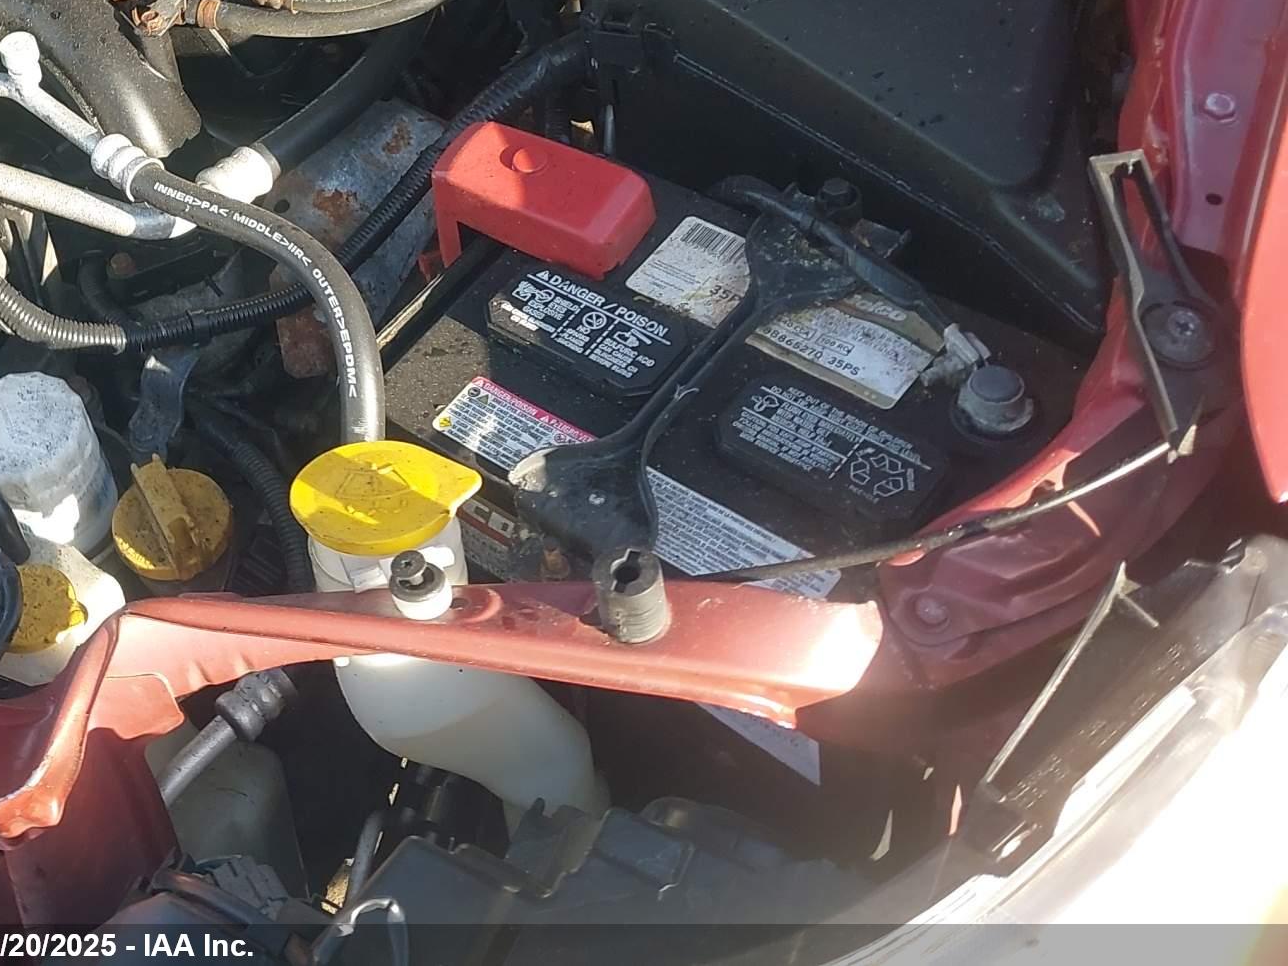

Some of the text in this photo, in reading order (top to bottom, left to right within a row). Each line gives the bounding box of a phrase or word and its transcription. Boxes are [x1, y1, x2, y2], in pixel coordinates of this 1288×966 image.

[154, 181, 357, 398] INNER>PA< MIDDLE>IIR< OUTER>EPDM<
[549, 275, 606, 307] DANGER
[615, 306, 669, 337] POISON
[603, 337, 655, 367] SULFURIC ACID
[827, 356, 861, 376] 35PS
[483, 383, 538, 417] DANGER/POISON
